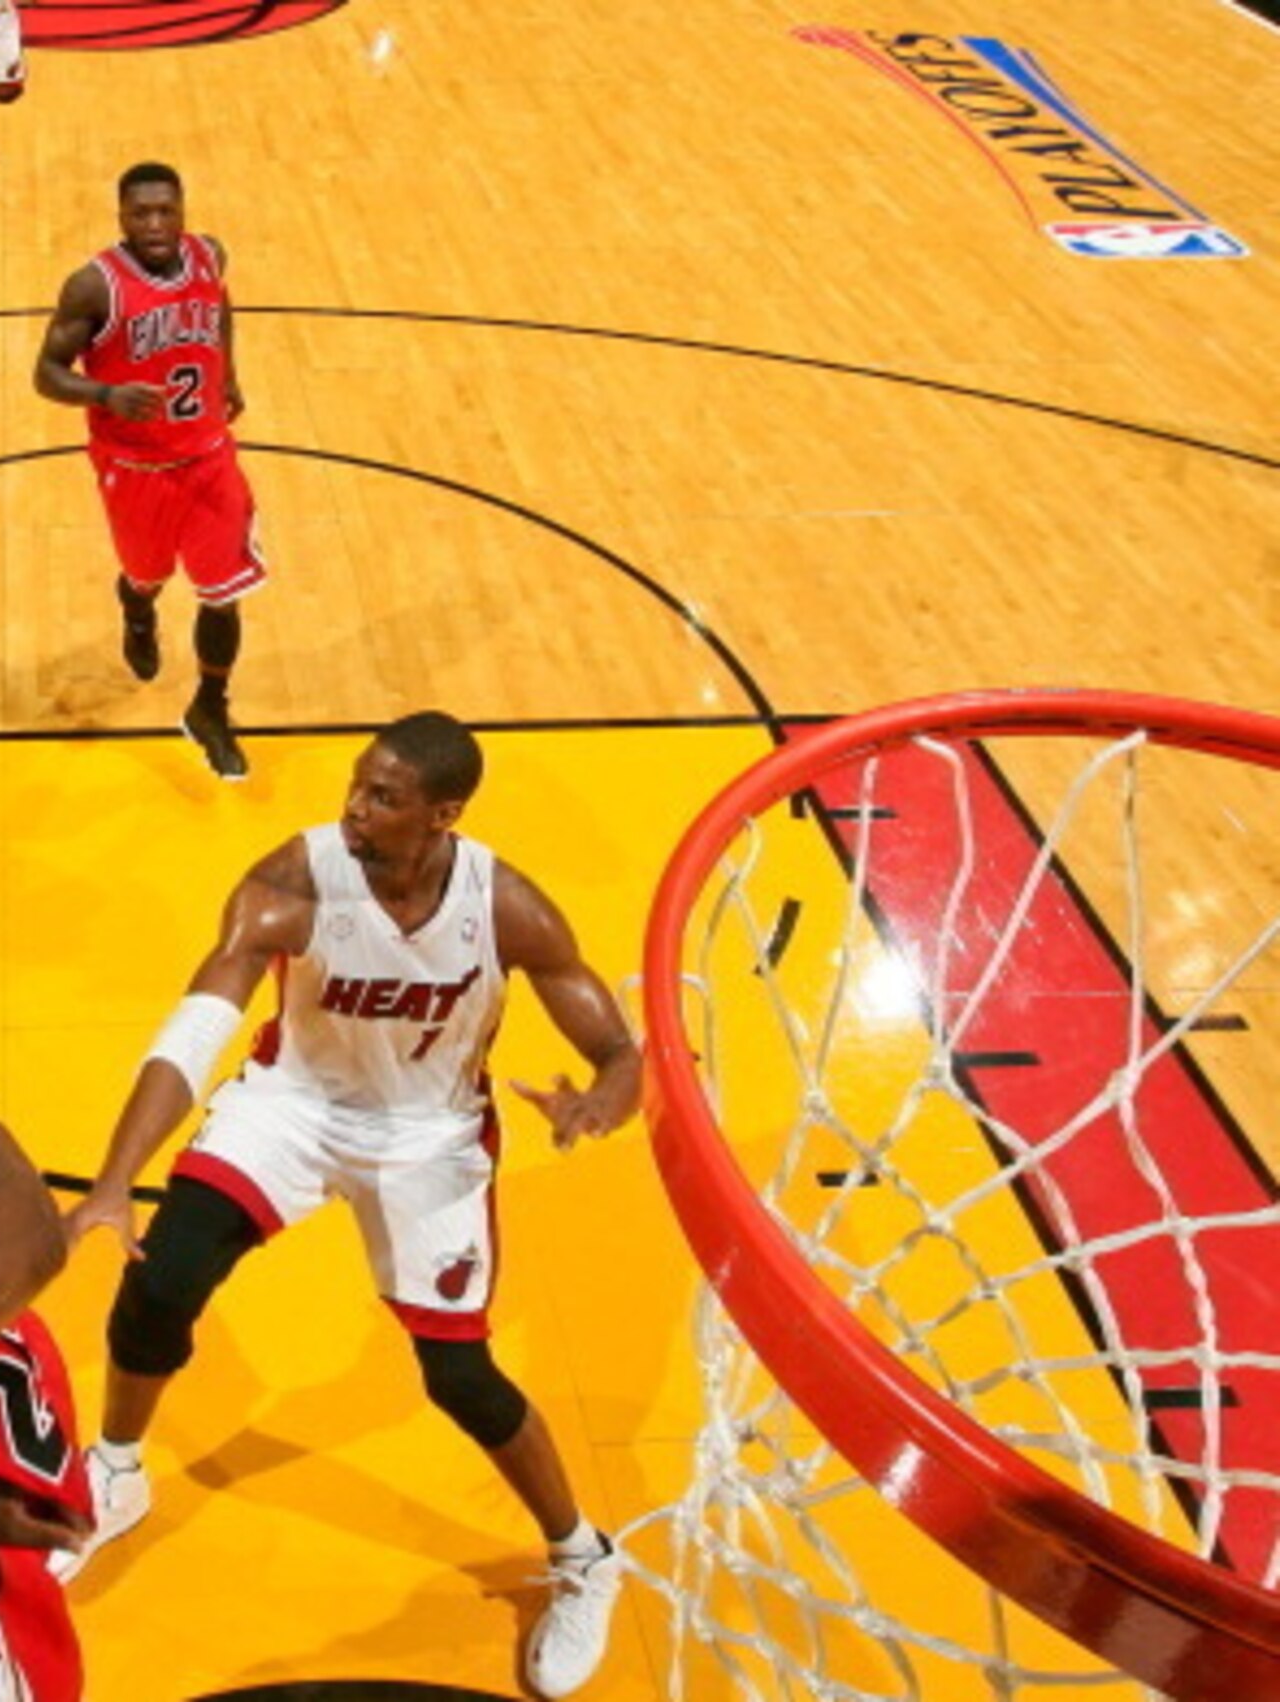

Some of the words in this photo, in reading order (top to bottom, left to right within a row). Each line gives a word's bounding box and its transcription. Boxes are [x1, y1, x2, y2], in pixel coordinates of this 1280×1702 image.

[866, 28, 1182, 220] PLAYOFFS
[167, 364, 204, 422] 2
[319, 965, 482, 1022] HEAT
[409, 1025, 445, 1061] 1
